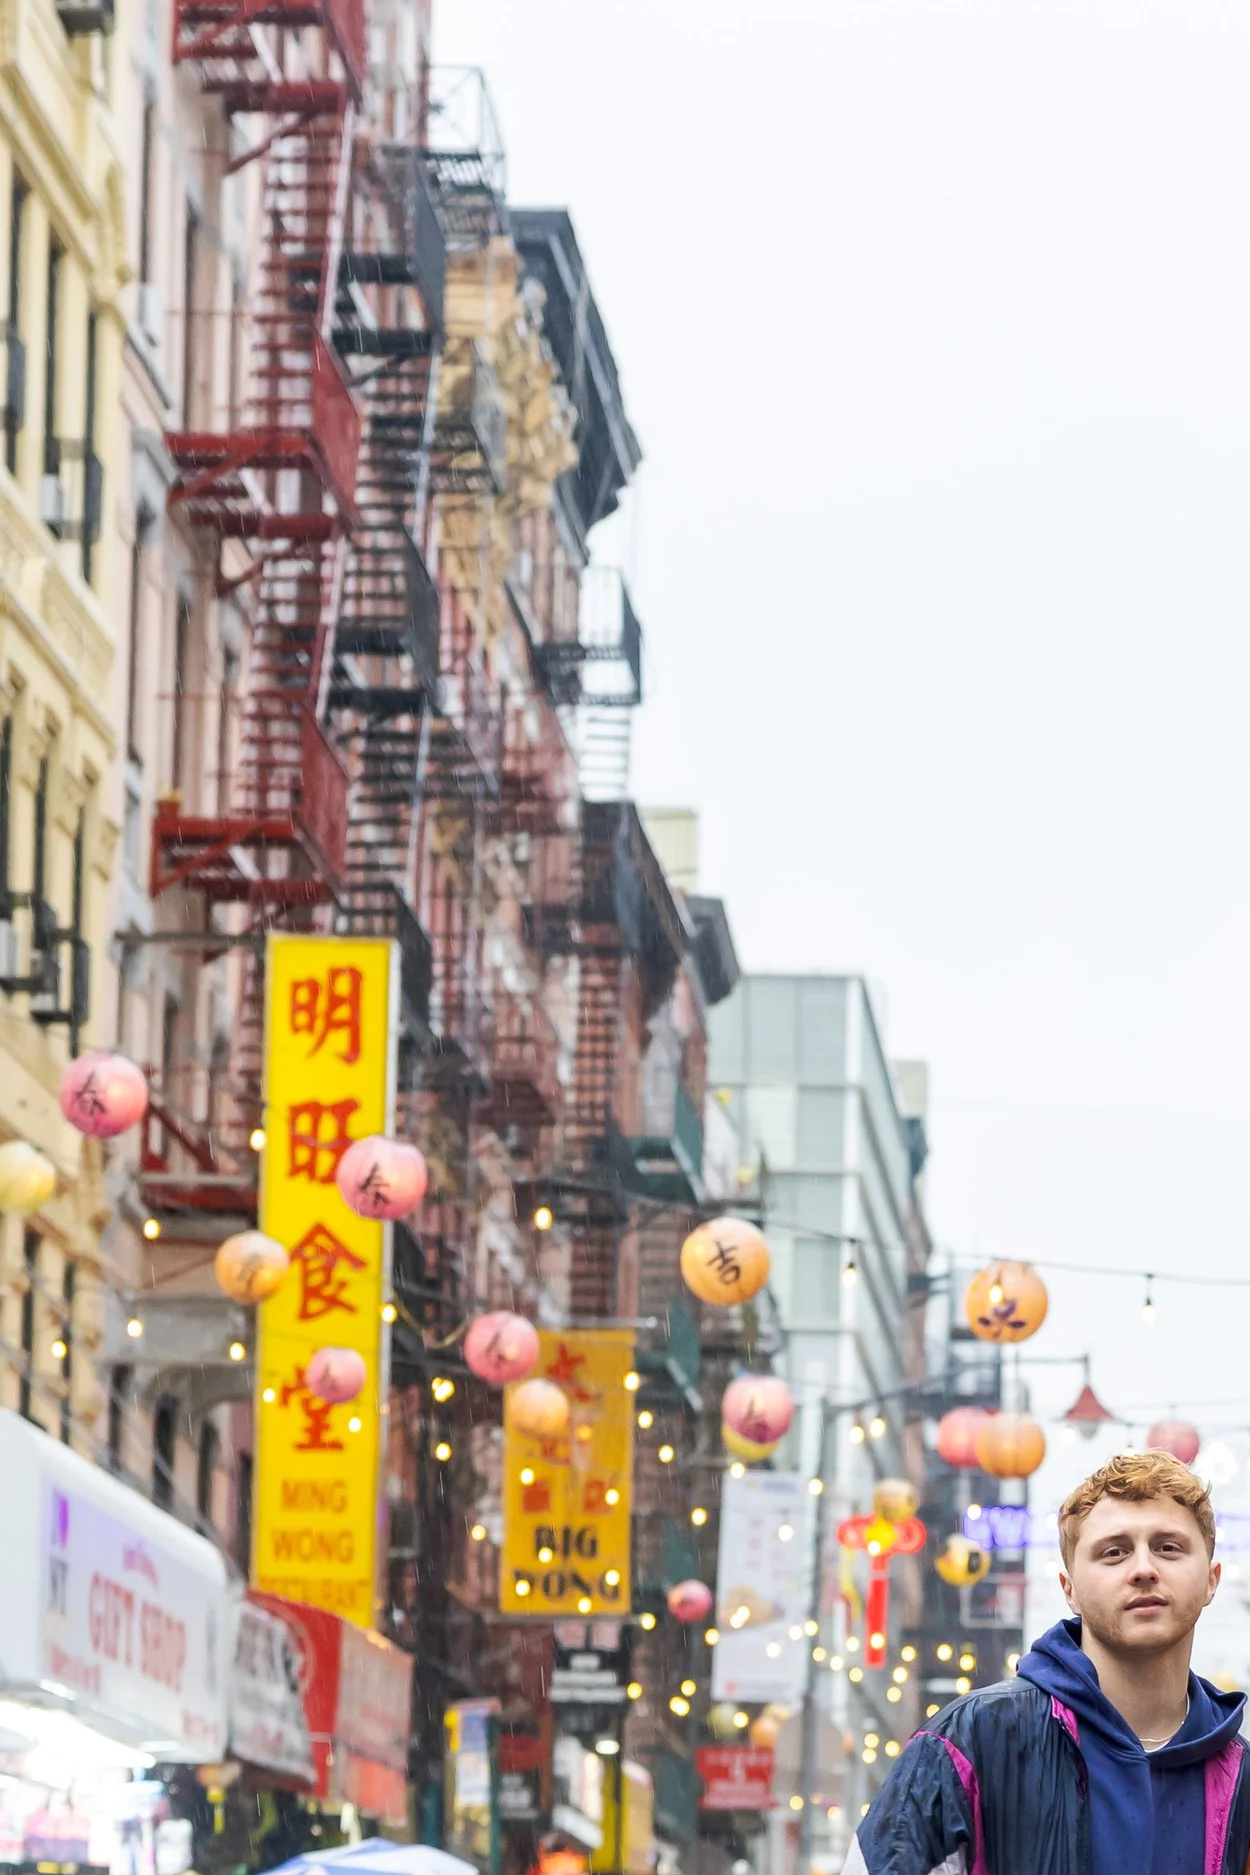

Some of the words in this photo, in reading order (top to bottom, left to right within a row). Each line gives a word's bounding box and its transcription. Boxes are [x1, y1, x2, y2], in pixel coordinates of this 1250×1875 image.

[281, 1479, 348, 1514] MING
[271, 1528, 354, 1566] WONG
[533, 1525, 599, 1561] BIG
